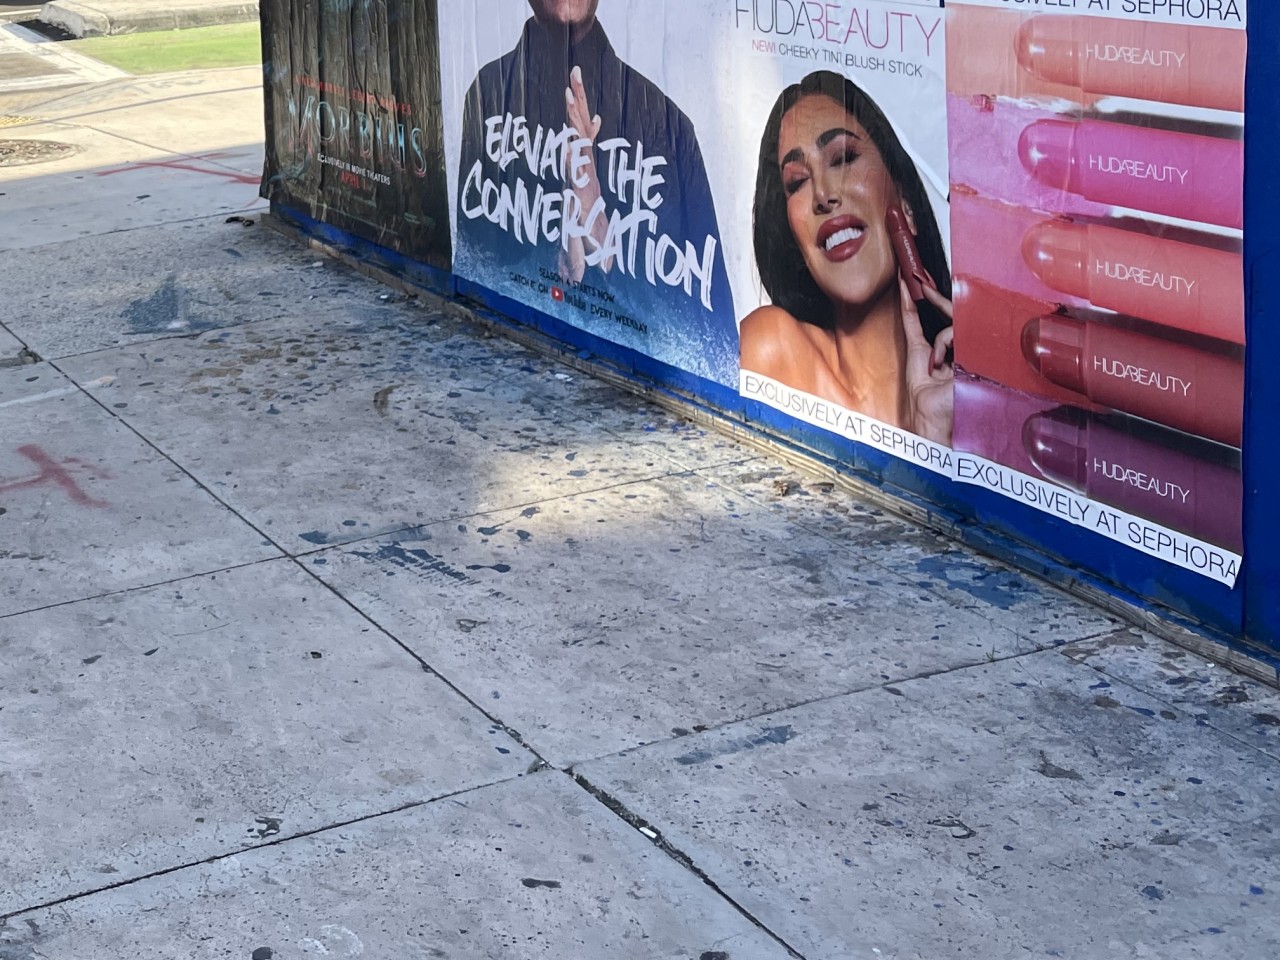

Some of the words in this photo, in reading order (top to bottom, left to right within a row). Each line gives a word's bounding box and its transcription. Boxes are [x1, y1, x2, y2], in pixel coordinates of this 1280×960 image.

[778, 42, 820, 60] CHEEKY
[845, 53, 886, 71] BLUSH
[888, 59, 923, 78] STICK
[485, 112, 593, 188] ELEVATE
[597, 137, 668, 210] THE
[461, 159, 717, 312] CONVERSATION
[538, 283, 549, 295] ON
[590, 303, 613, 321] EVERY
[539, 266, 563, 285] SEASON
[572, 280, 596, 297] STARTS
[596, 290, 616, 303] NOW
[746, 375, 842, 427] EXCLUSIVELY
[844, 415, 865, 436] AT
[870, 422, 952, 469] SEPHORA
[957, 458, 1089, 522] EXCLUSIVELY
[1096, 509, 1120, 535] AT
[1128, 521, 1236, 580] SEPHORA
